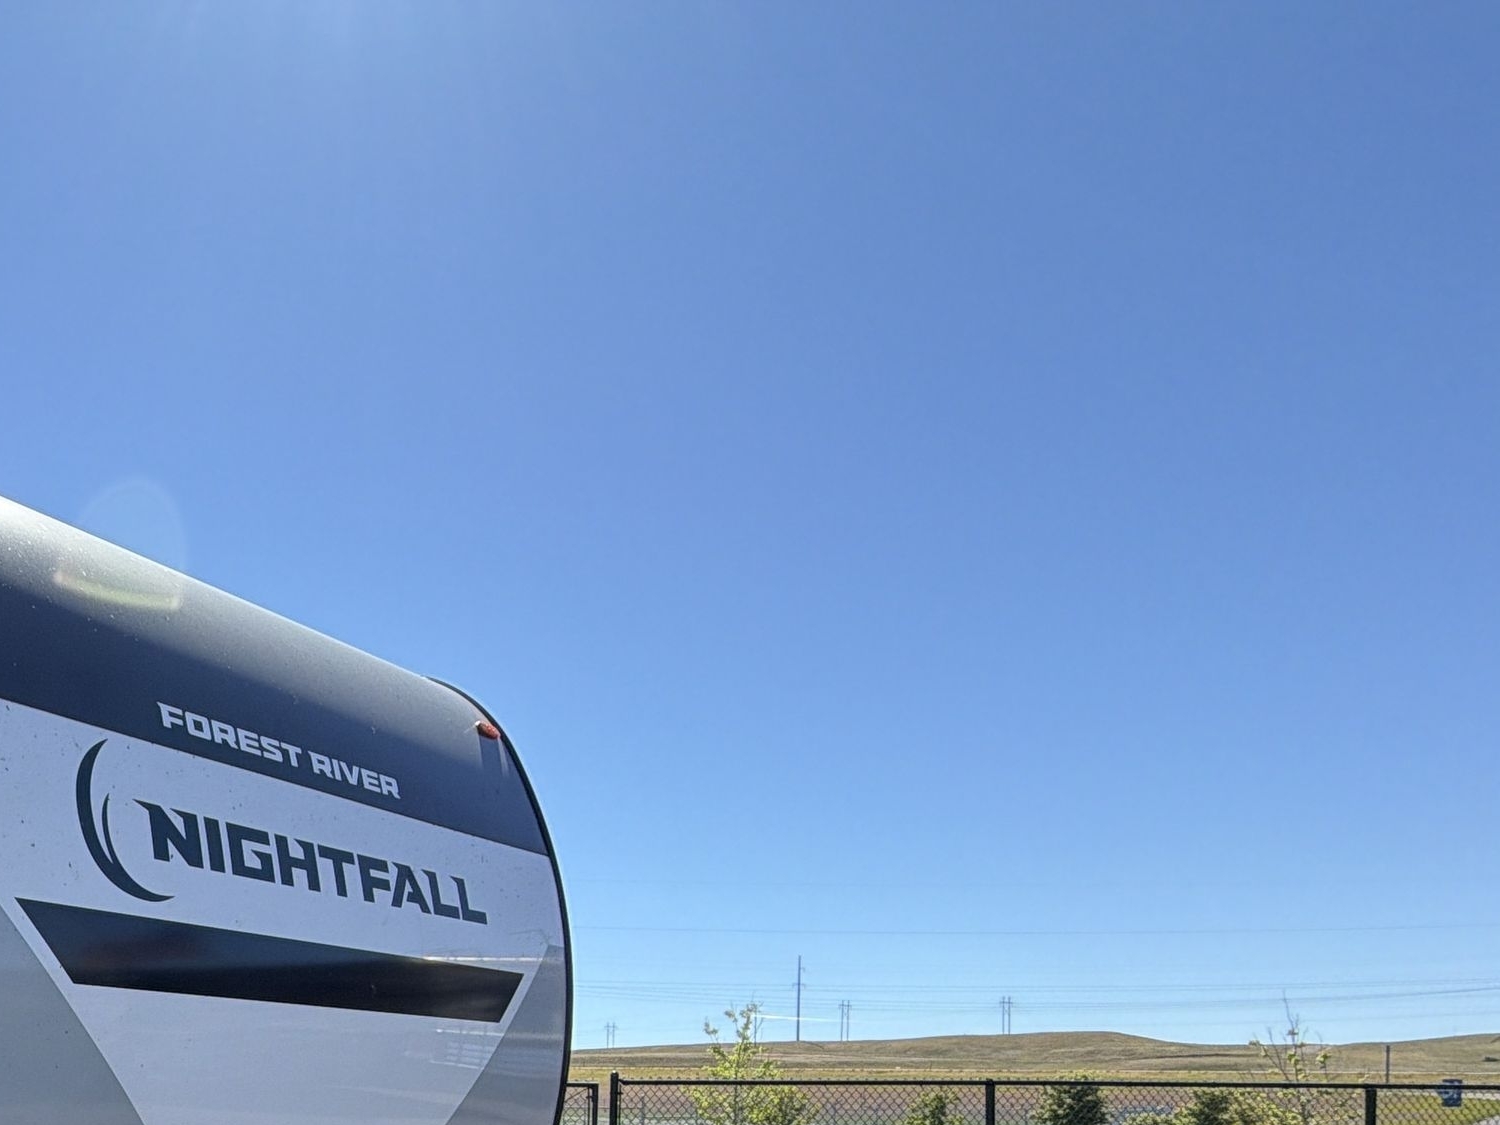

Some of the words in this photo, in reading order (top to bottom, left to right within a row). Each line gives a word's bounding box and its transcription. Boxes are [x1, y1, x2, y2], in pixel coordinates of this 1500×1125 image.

[156, 701, 302, 767] FOREST
[308, 752, 401, 799] RIVER
[134, 799, 488, 925] NIGHTFALL
